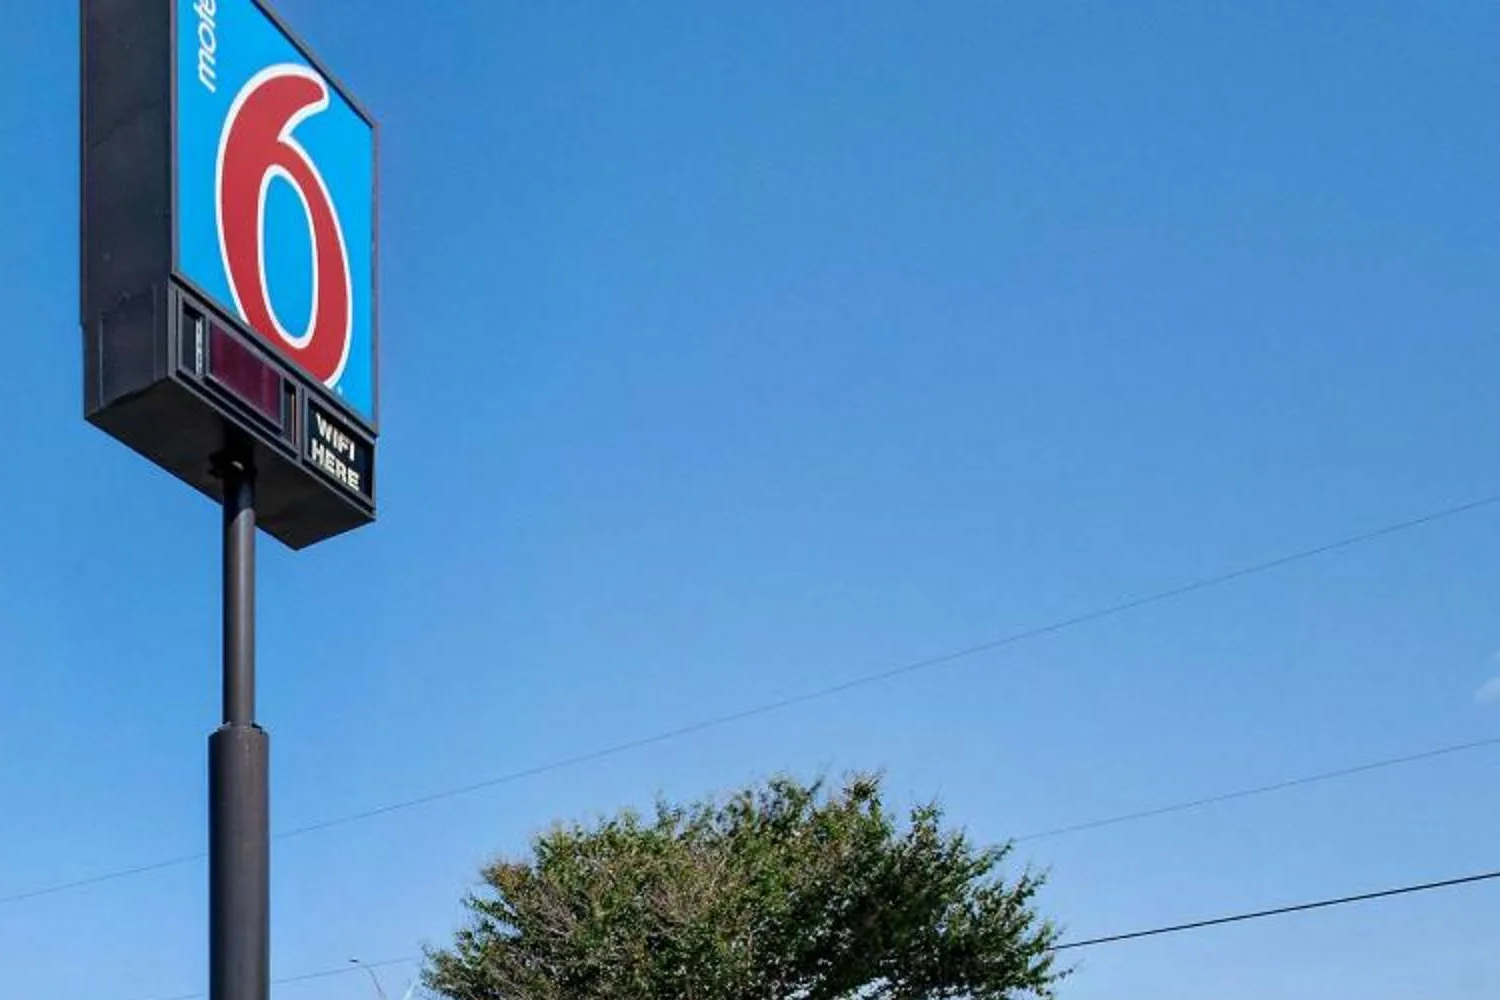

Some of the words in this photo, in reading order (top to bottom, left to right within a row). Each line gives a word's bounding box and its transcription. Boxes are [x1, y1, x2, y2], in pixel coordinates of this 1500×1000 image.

[215, 63, 353, 389] 6
[315, 412, 355, 461] WIFI
[311, 437, 360, 491] HERE
